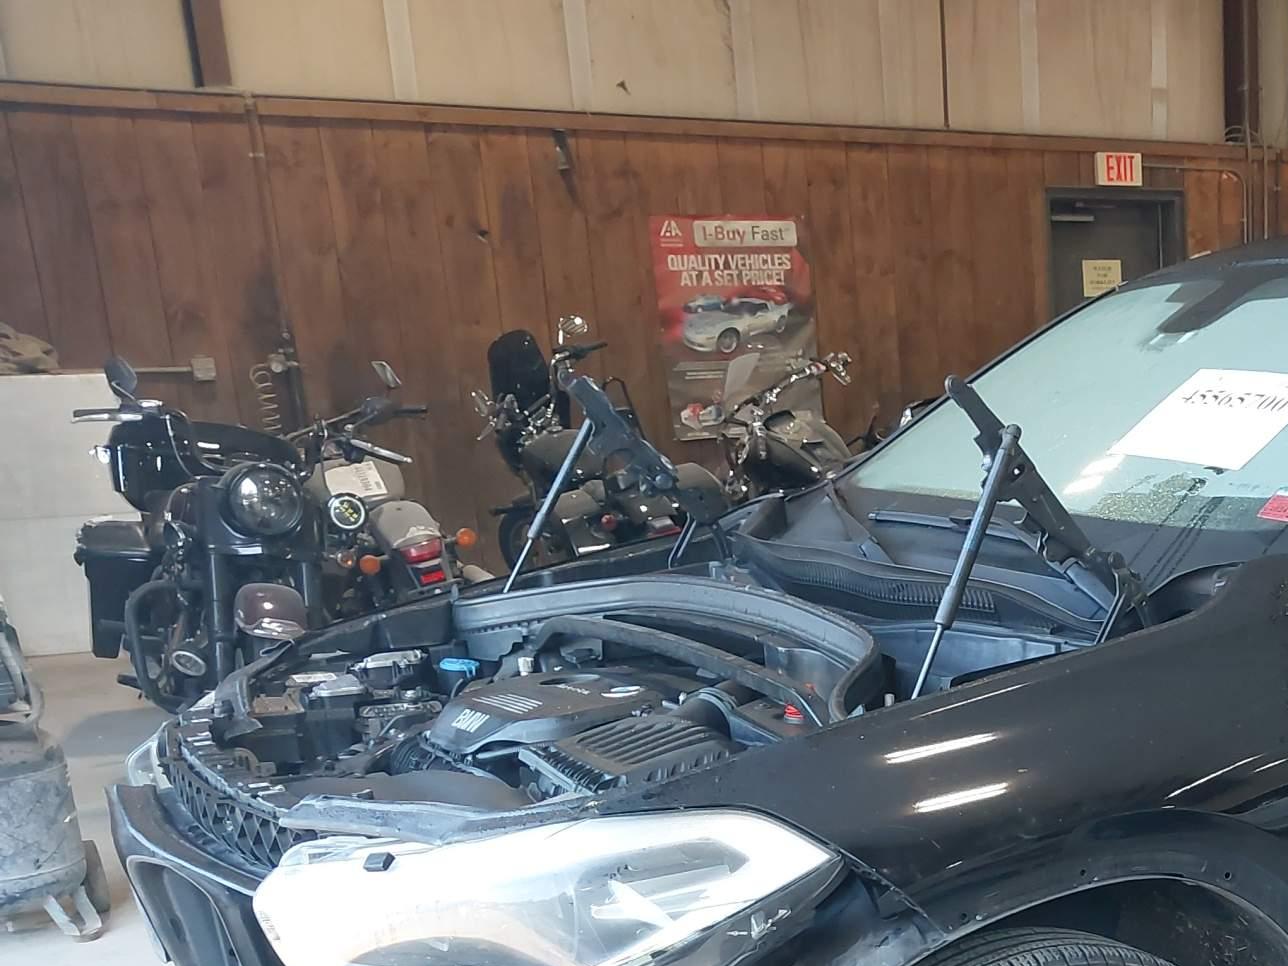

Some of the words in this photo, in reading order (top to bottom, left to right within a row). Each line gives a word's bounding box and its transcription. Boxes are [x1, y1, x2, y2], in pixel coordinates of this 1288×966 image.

[1105, 154, 1135, 182] EXIT
[702, 225, 746, 244] I-Buy
[751, 225, 785, 241] Fast
[667, 254, 726, 271] QUALITY
[727, 253, 792, 270] VEHICLES
[680, 271, 700, 287] AT
[701, 271, 713, 286] A
[714, 270, 740, 286] SET
[742, 269, 786, 286] PRICE!
[451, 708, 490, 732] BMW
